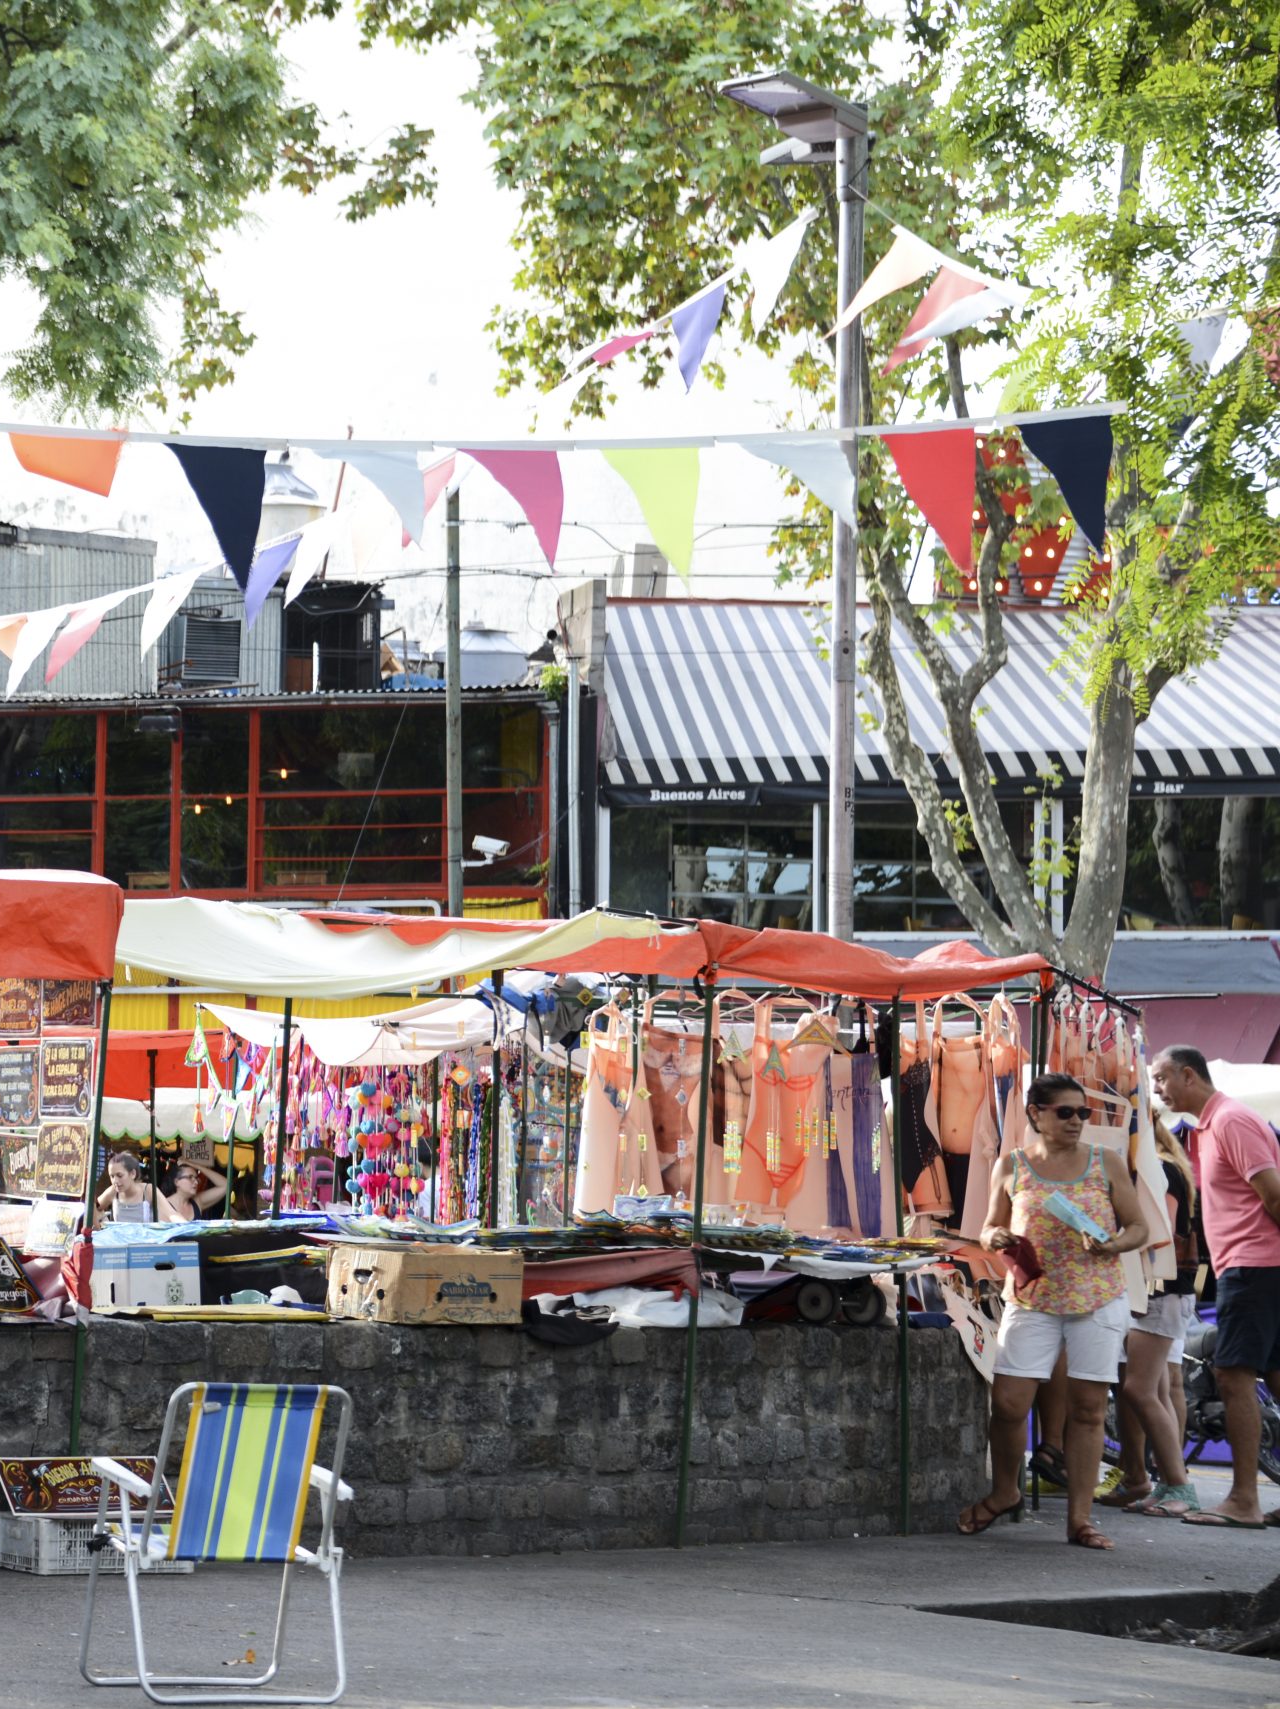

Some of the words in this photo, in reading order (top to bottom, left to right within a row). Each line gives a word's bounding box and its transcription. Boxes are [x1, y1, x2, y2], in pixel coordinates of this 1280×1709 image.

[1153, 781, 1185, 794] Bar
[650, 789, 704, 801] Buenos
[707, 788, 746, 800] Aires
